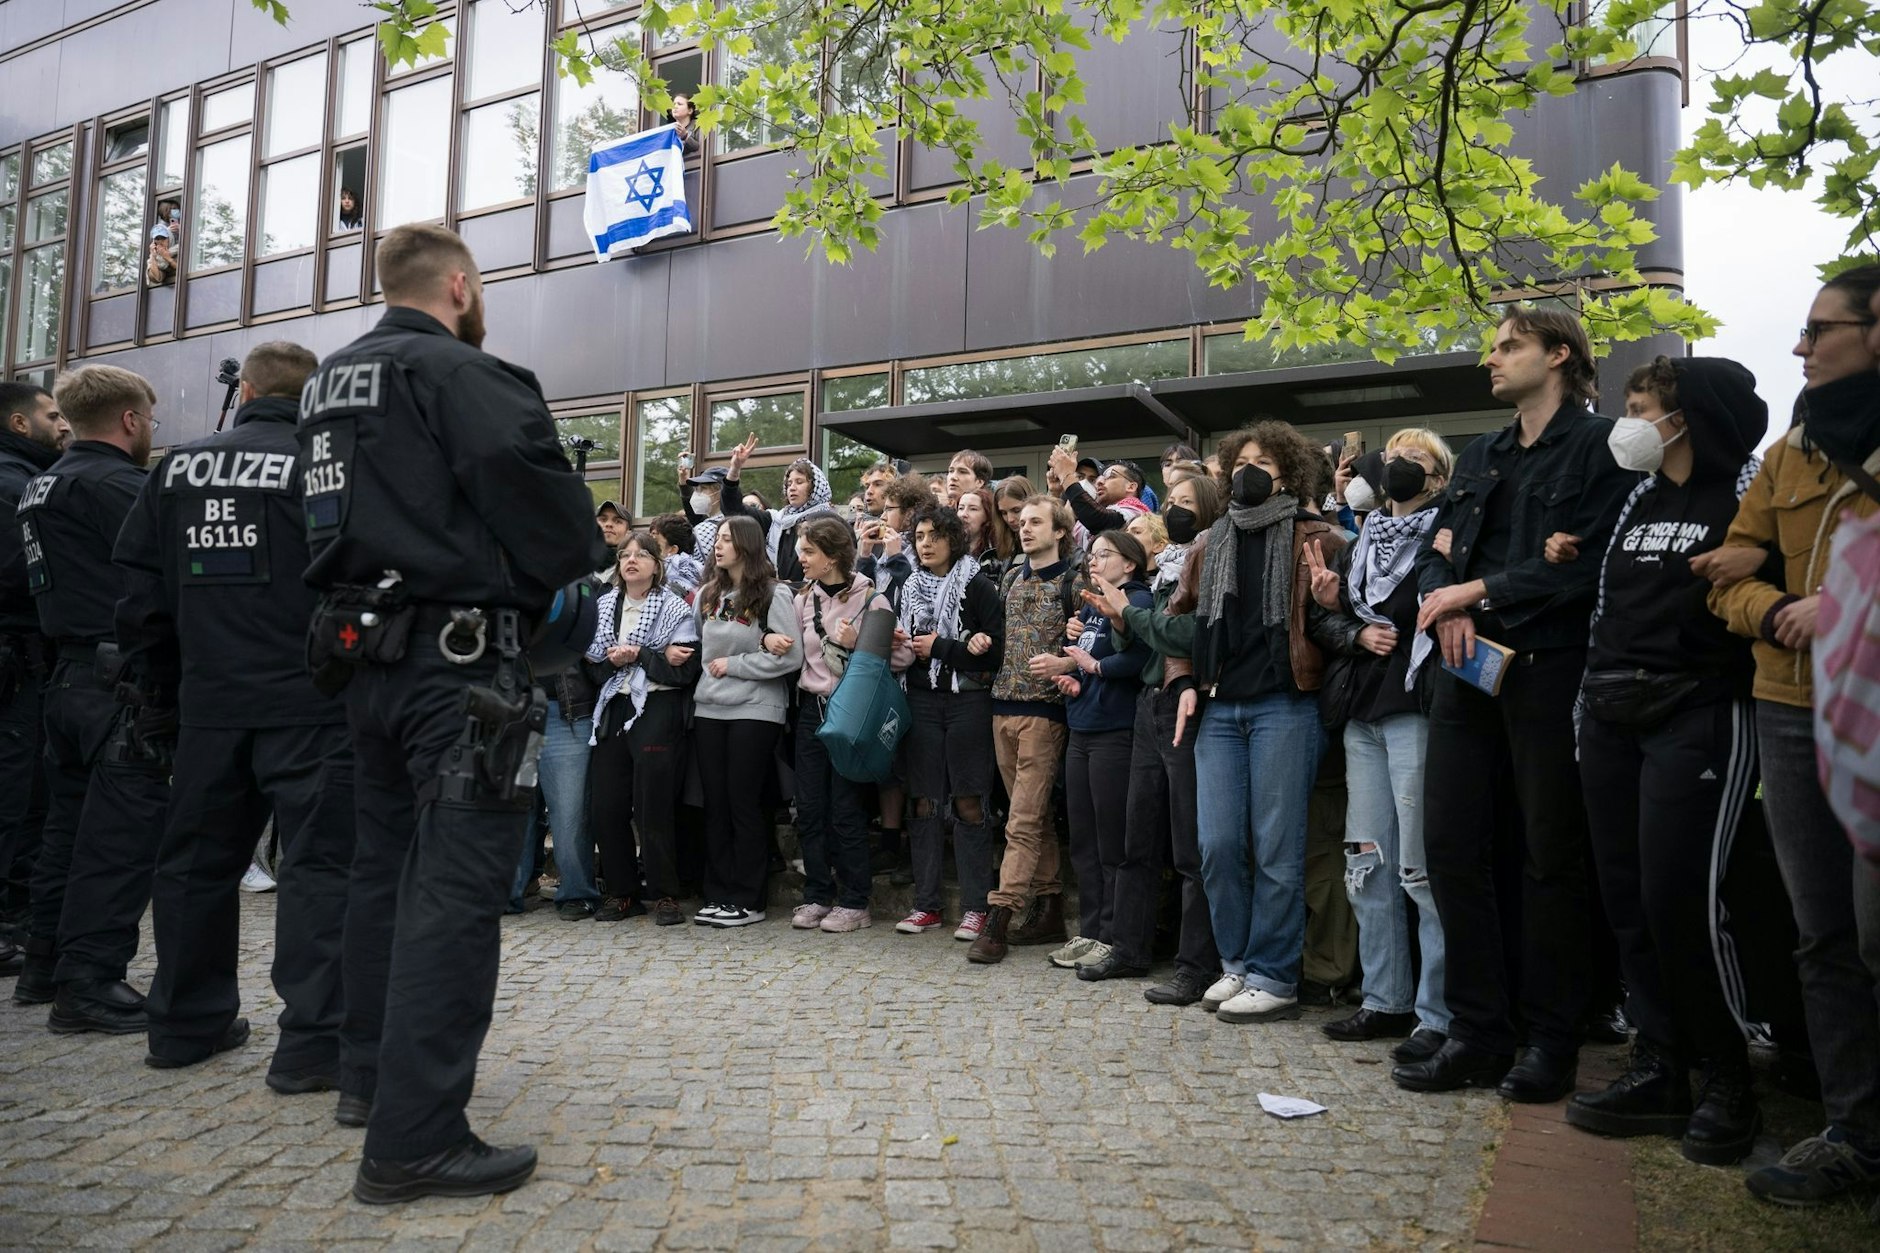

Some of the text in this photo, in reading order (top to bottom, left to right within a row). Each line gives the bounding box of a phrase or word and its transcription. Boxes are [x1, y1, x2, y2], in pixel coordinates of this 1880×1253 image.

[300, 362, 382, 419] OLIZEI
[312, 431, 332, 462] BE
[164, 451, 296, 490] POLIZEI
[304, 461, 346, 496] 16115
[204, 498, 237, 521] BE
[186, 524, 258, 548] 16116
